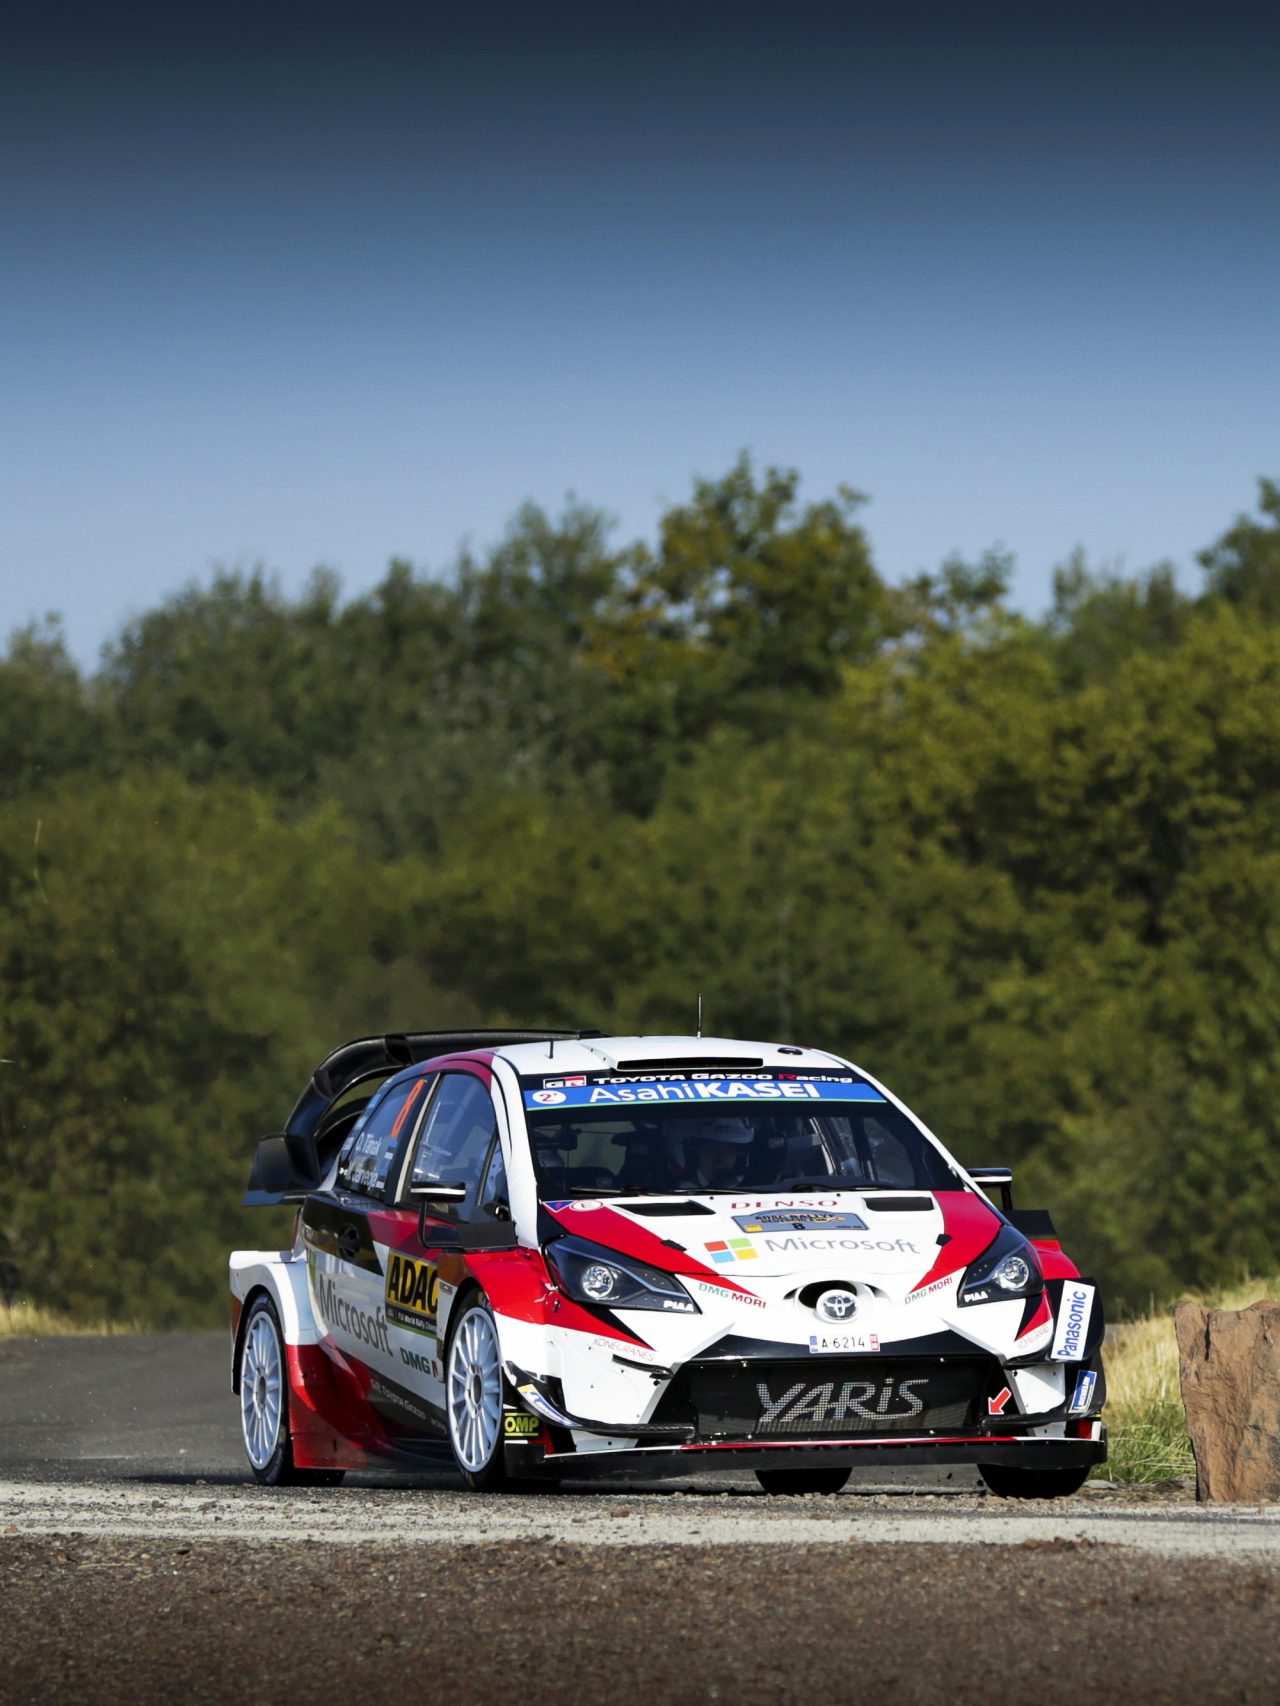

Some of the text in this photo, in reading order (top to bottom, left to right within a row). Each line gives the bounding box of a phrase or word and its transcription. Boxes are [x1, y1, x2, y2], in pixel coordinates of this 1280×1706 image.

[593, 1074, 686, 1085] TOYOTA
[778, 1073, 853, 1084] Racing
[390, 1079, 428, 1137] 8
[731, 1200, 838, 1209] DENSO
[764, 1237, 921, 1254] Microsoft
[387, 1255, 439, 1315] ADAC
[698, 1283, 767, 1309] DMG MORI
[904, 1276, 953, 1304] DMG MORI
[963, 1291, 989, 1303] PIAA
[319, 1273, 394, 1357] Microsoft
[663, 1300, 695, 1312] PIAA
[1057, 1290, 1087, 1357] Panasonic
[400, 1347, 431, 1375] DMG
[593, 1337, 656, 1362] KONECRANES
[504, 1416, 540, 1432] OMP
